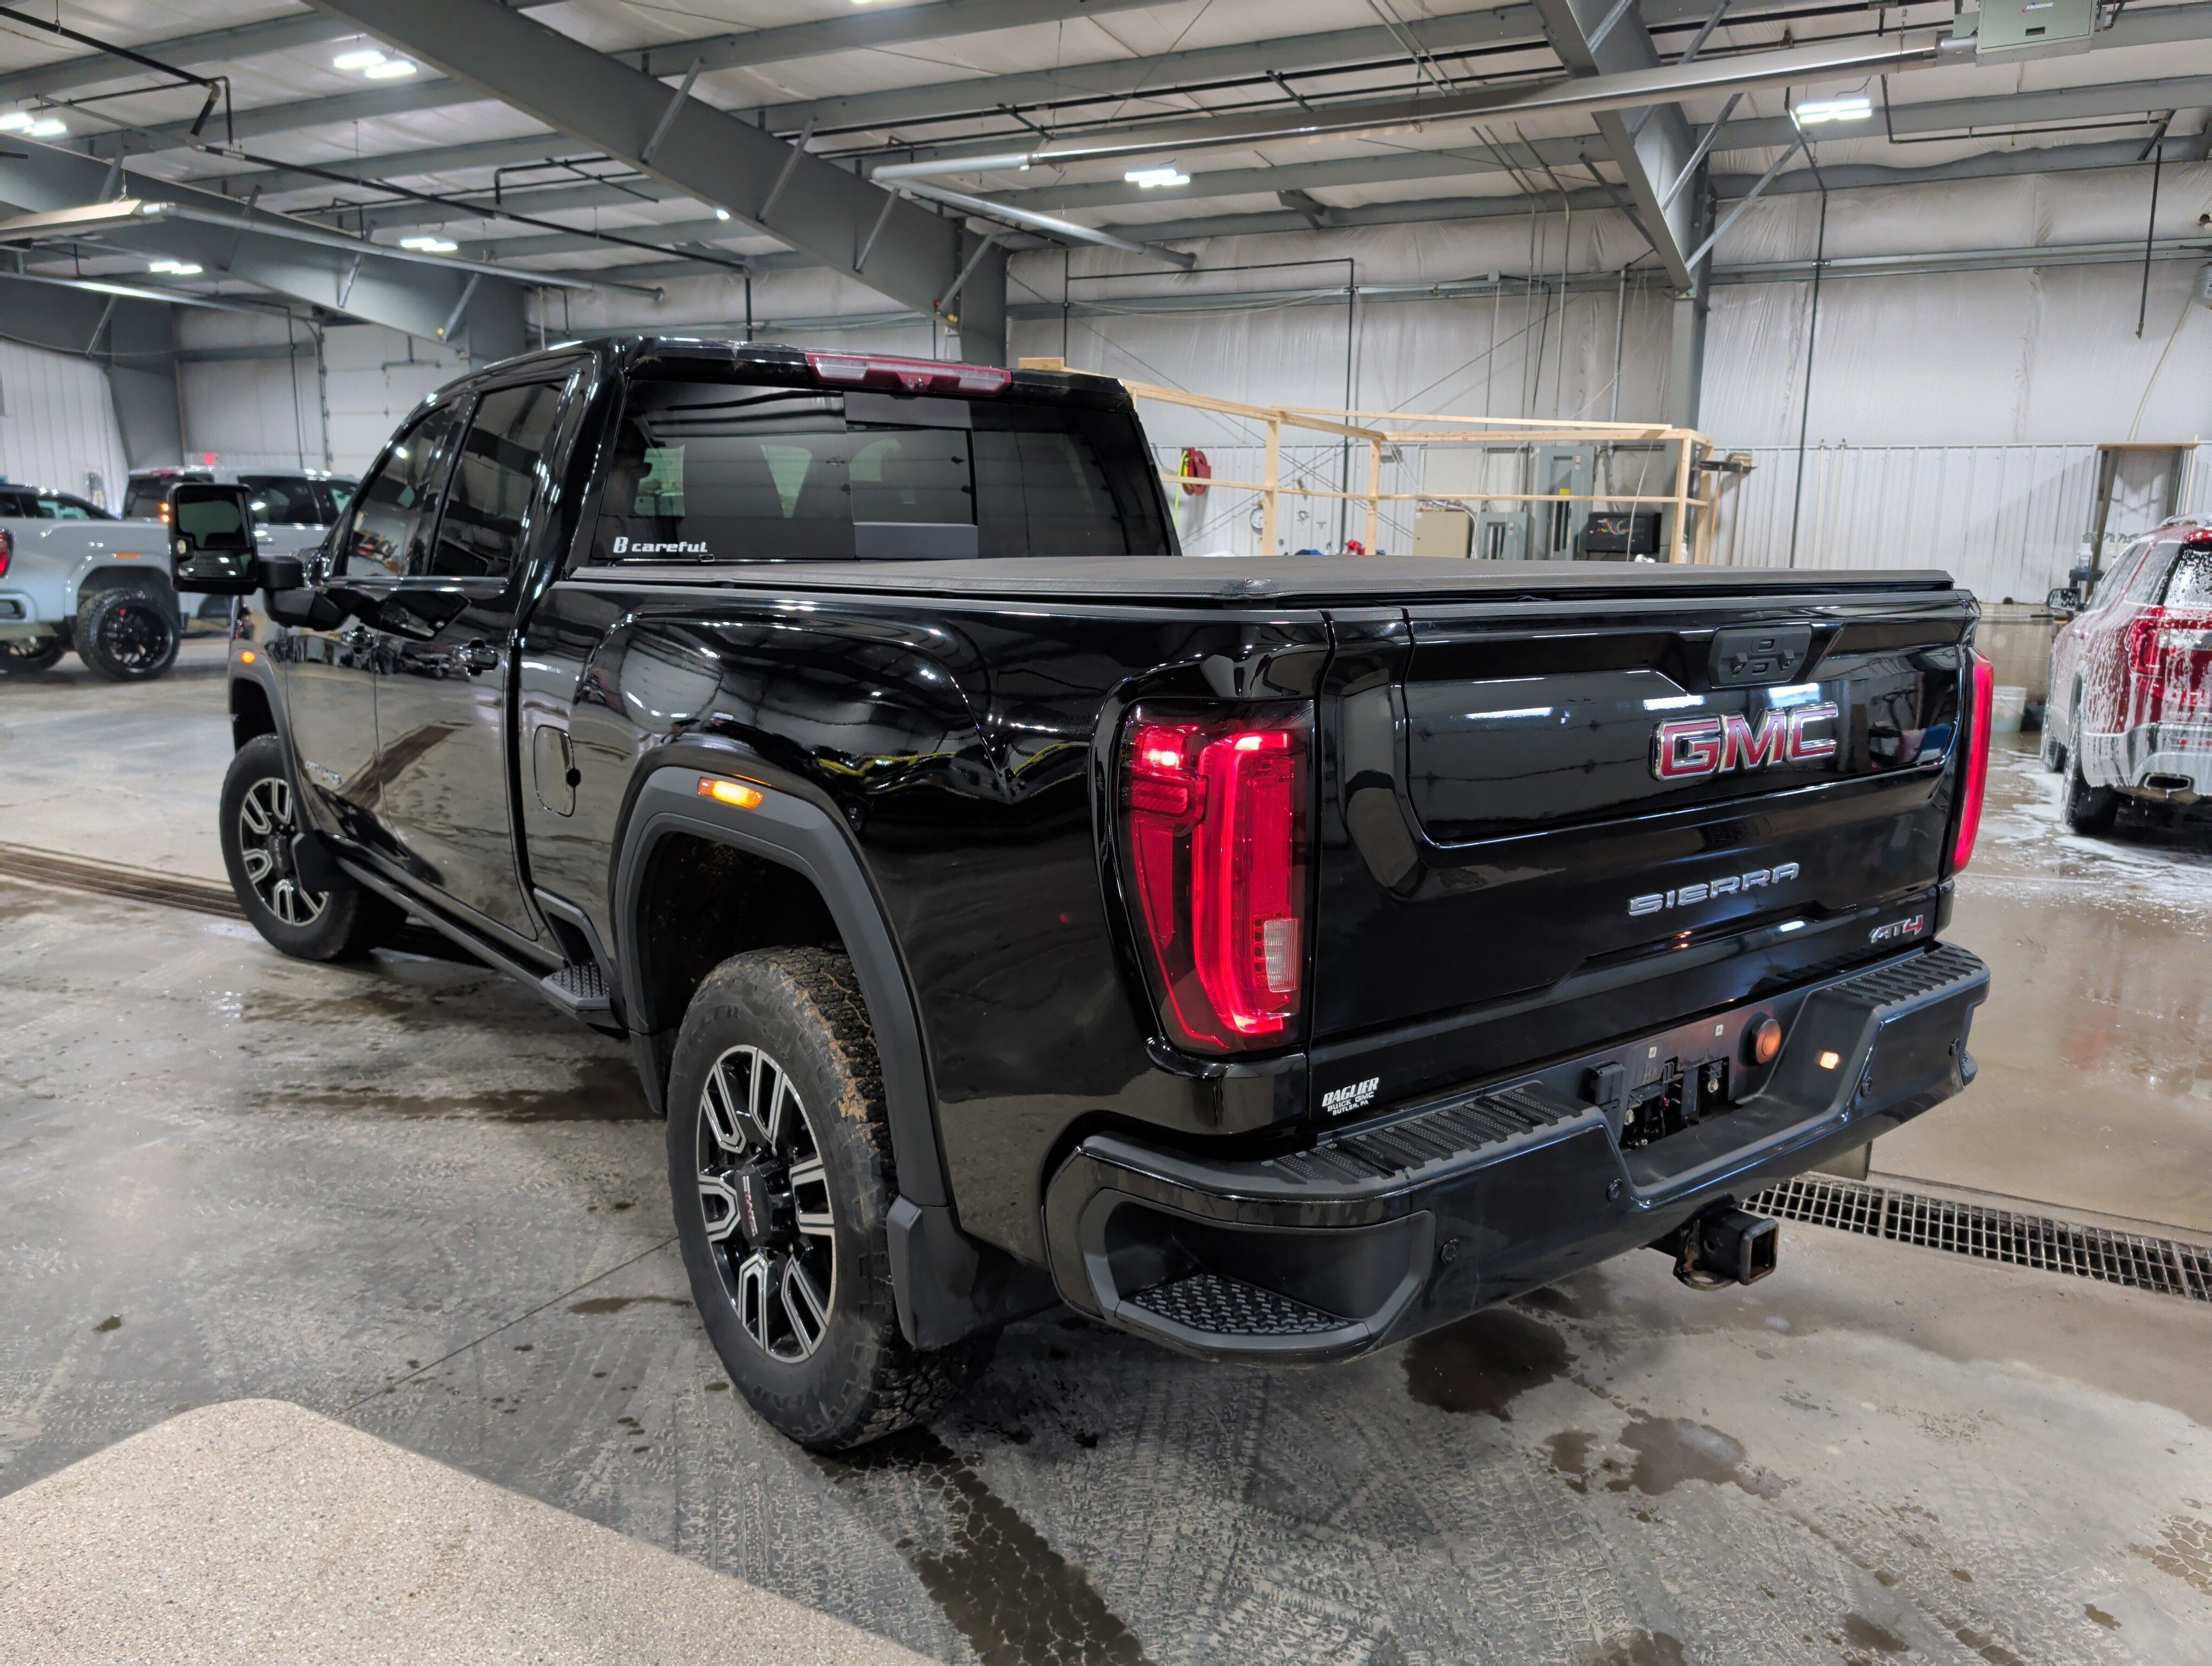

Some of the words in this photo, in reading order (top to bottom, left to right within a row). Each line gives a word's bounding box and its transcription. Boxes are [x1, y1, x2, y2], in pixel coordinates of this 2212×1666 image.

[613, 536, 629, 553] B
[631, 542, 708, 553] careful
[1650, 701, 1838, 781] GMC
[1628, 861, 1800, 917] SIERRA
[1869, 914, 1924, 944] AT4
[1322, 1077, 1379, 1107] BAGLIER
[1327, 1099, 1352, 1112] BUICK
[1355, 1091, 1374, 1103] GMC
